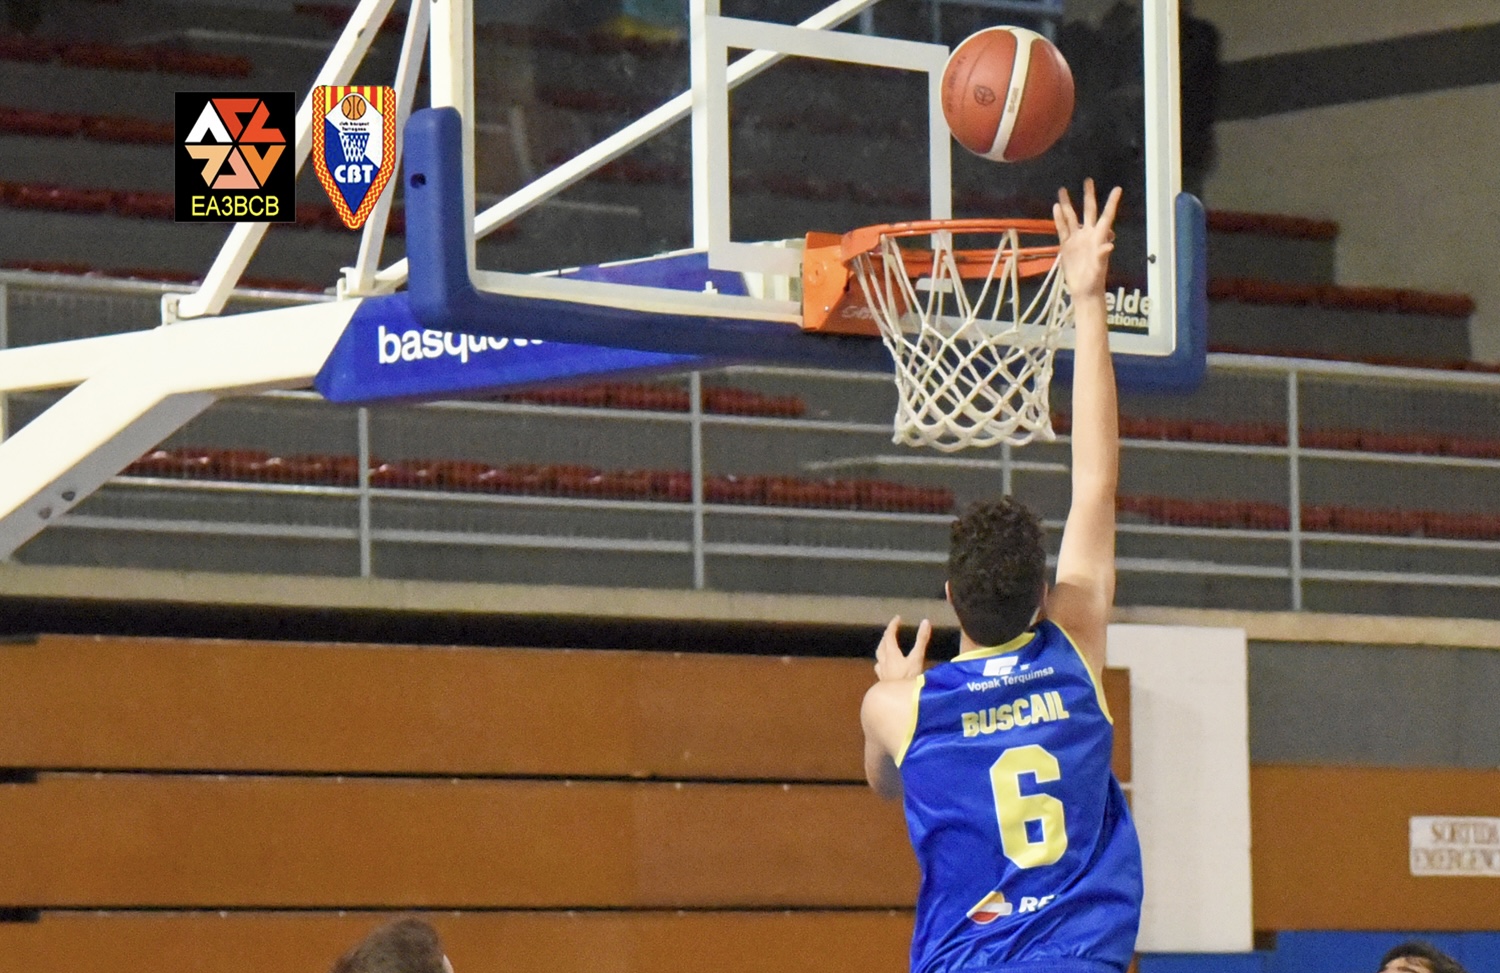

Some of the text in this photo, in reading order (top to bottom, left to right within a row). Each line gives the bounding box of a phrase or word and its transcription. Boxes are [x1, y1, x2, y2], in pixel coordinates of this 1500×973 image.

[967, 667, 1055, 692] Vopak Terquimsa
[961, 691, 1069, 737] BUSCAIL
[990, 744, 1068, 869] 6
